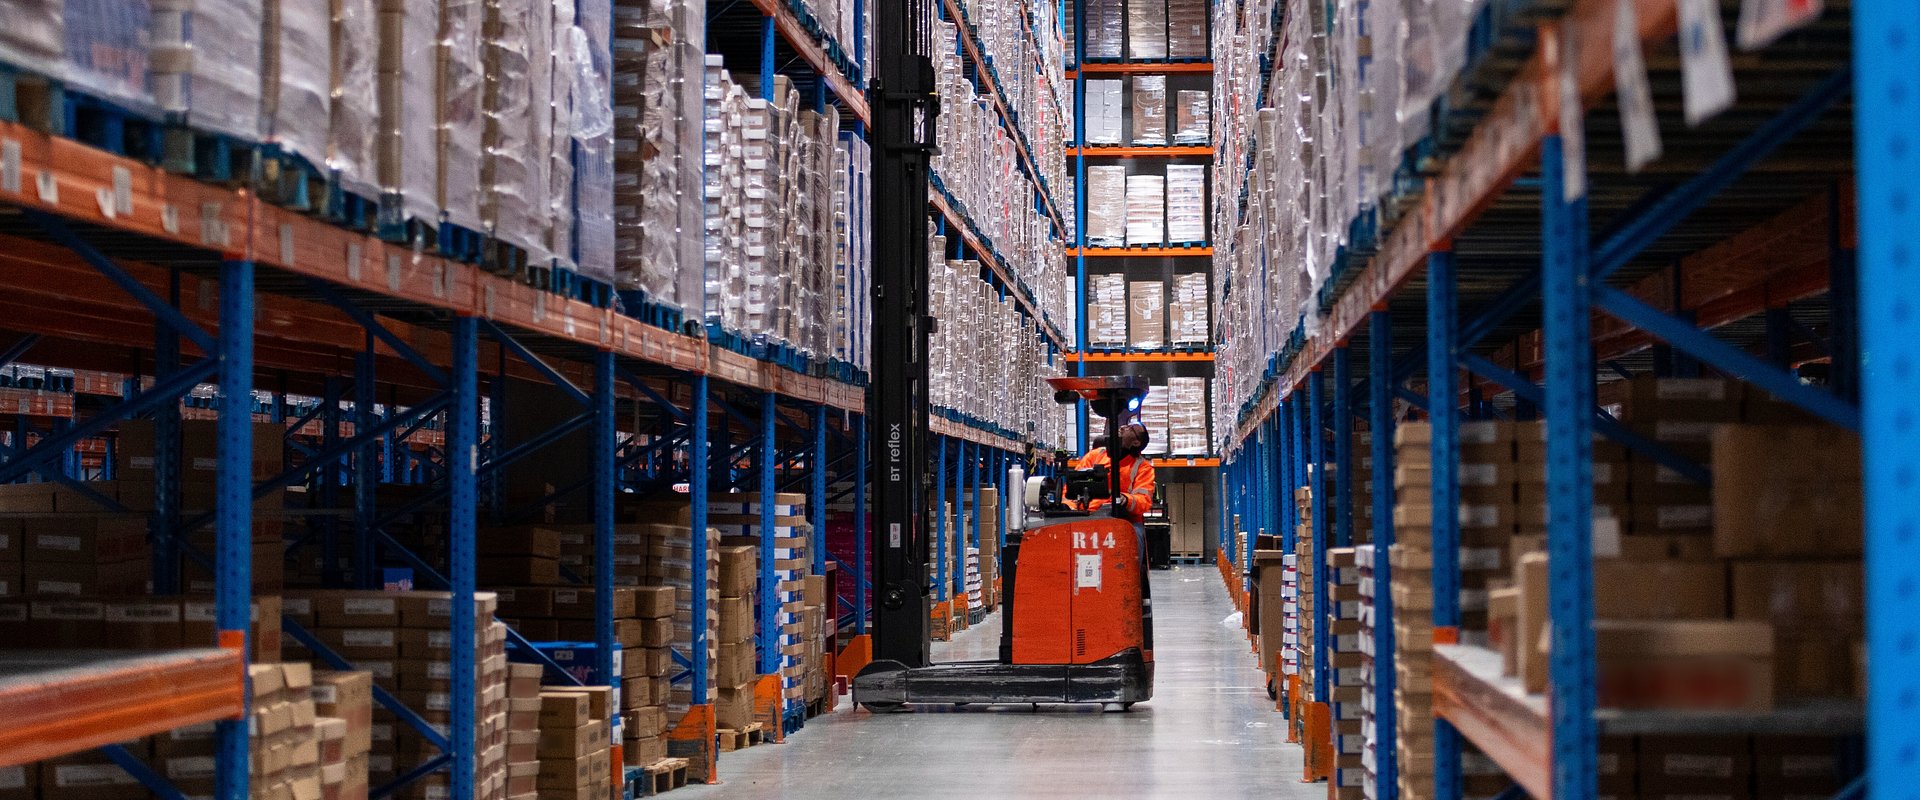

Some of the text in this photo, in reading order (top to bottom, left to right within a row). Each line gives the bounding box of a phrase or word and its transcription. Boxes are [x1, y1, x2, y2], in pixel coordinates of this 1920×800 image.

[888, 423, 900, 481] BT reflex
[1072, 532, 1116, 549] R14
